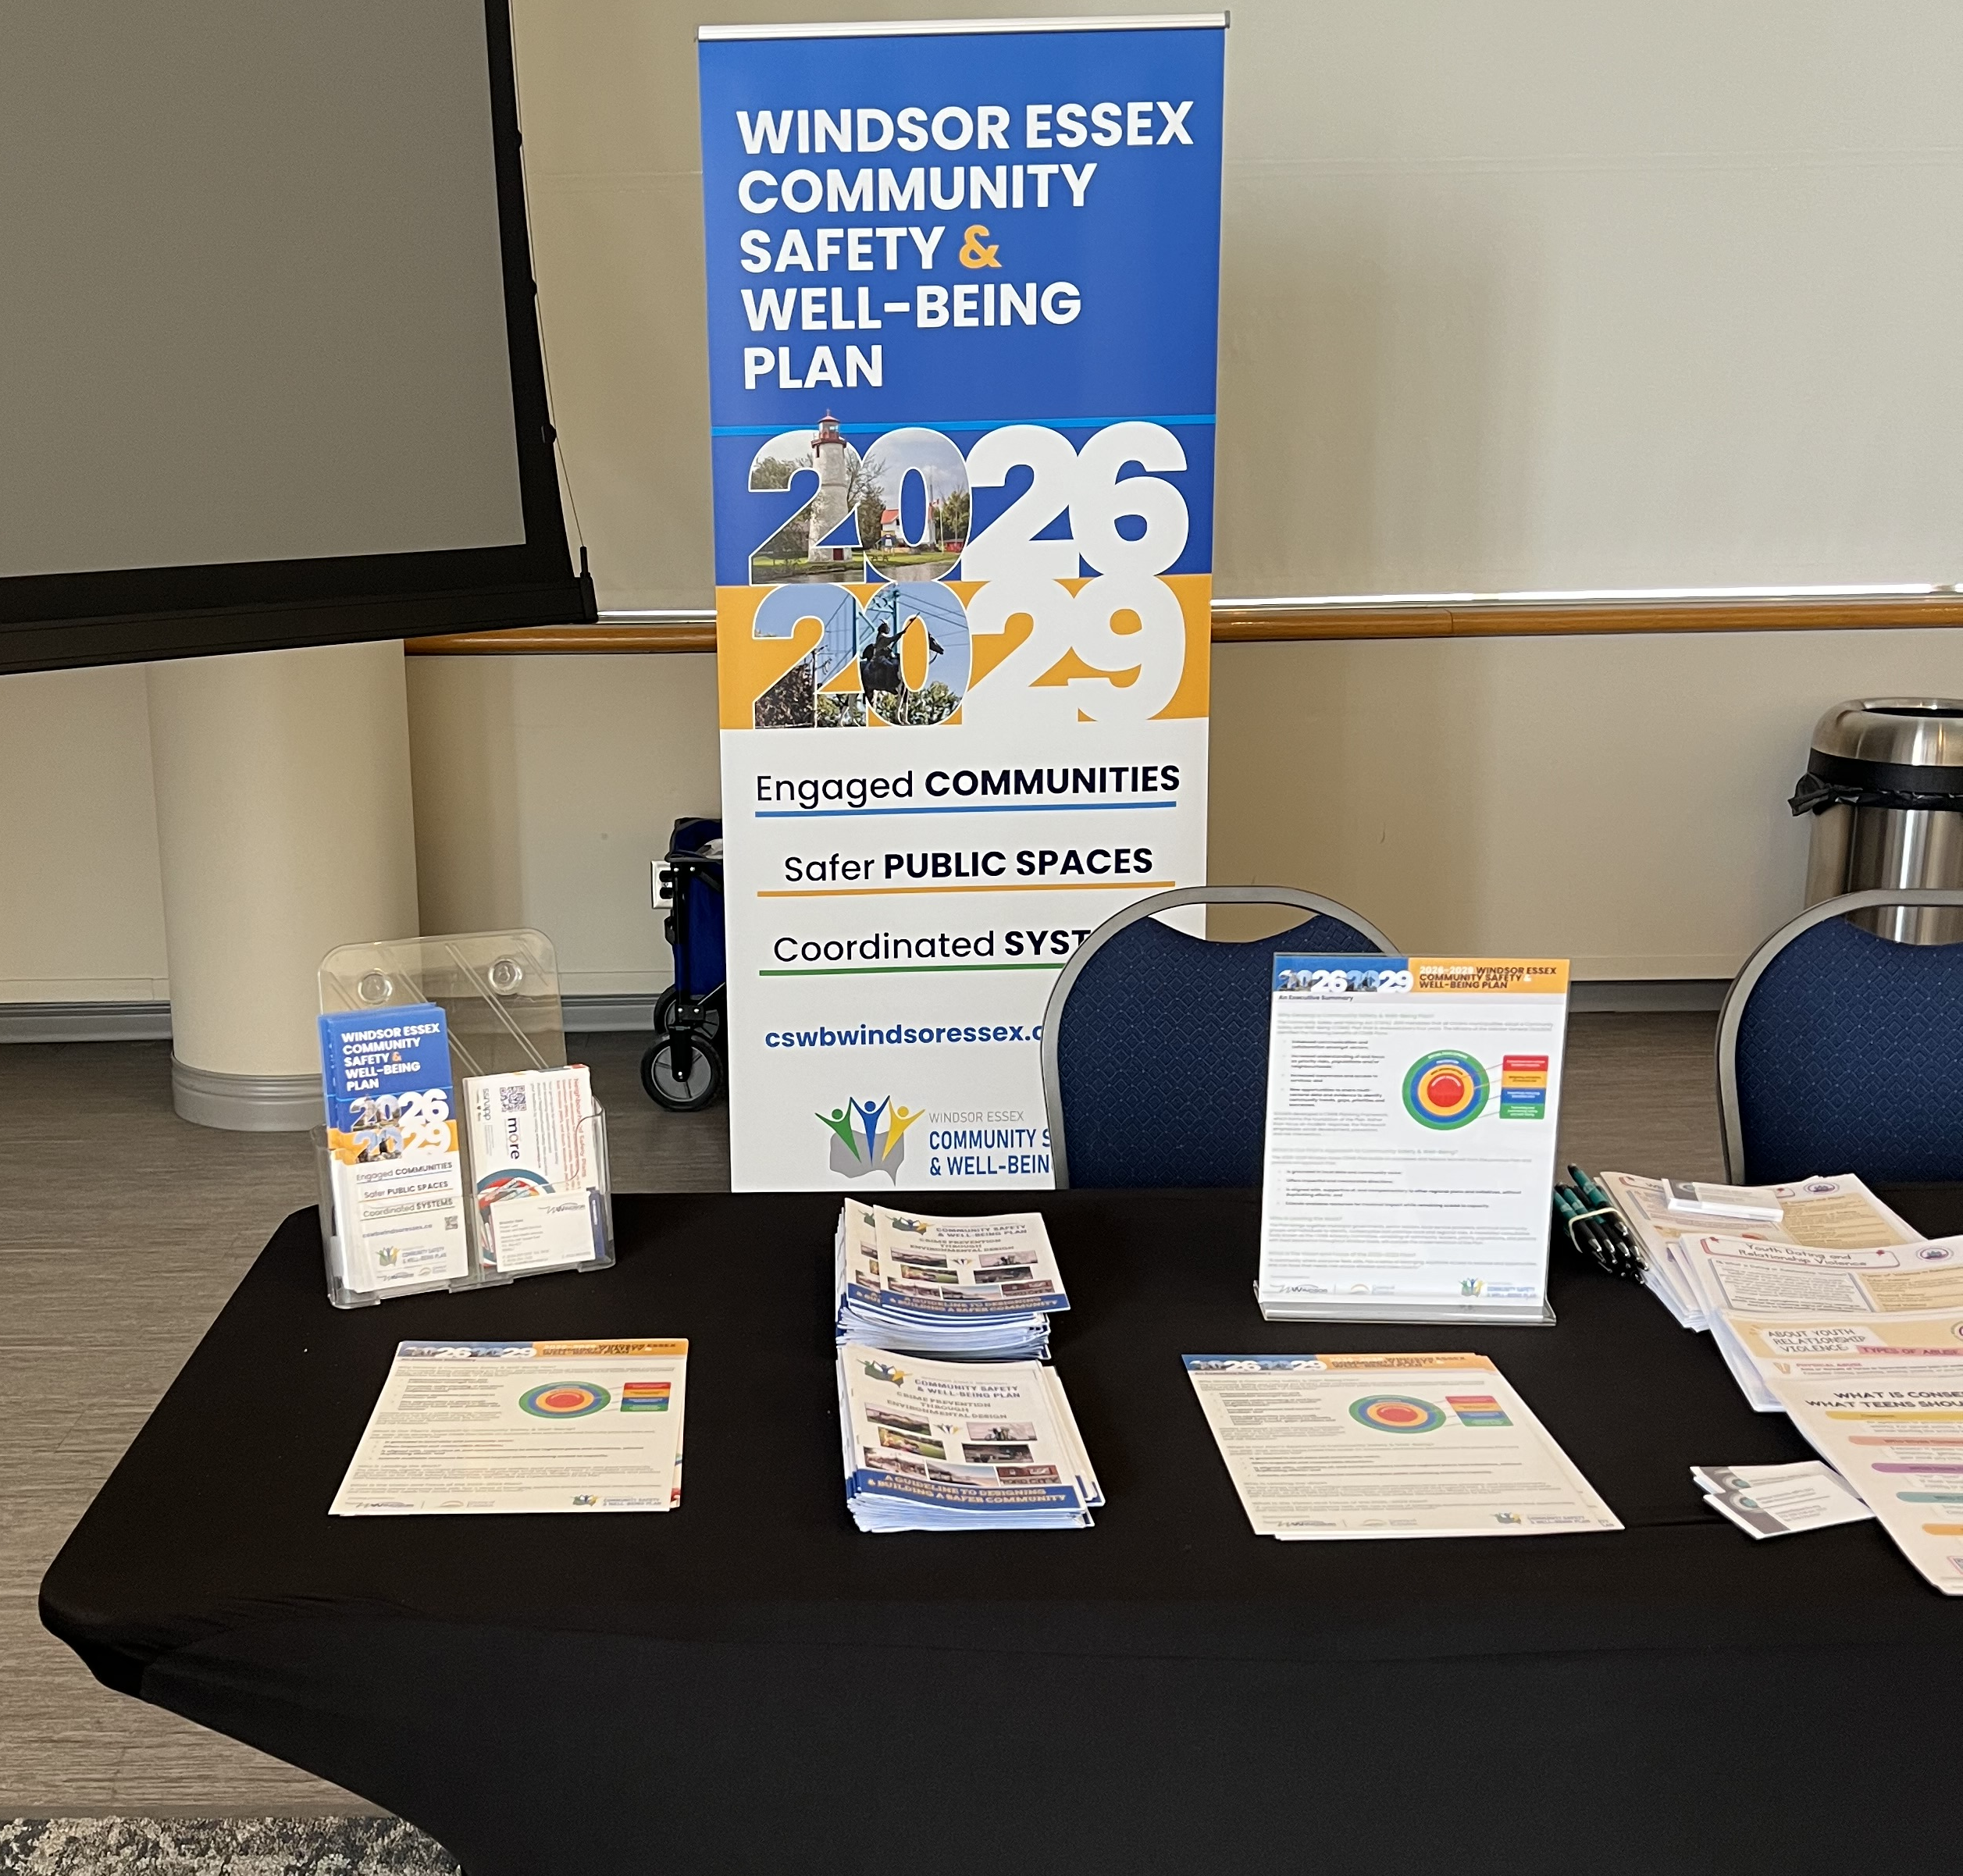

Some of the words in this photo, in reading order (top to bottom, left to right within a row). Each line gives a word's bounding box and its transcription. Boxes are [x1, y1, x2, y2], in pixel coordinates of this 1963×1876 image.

[736, 105, 1010, 155] WINDSOR
[1025, 101, 1194, 148] ESSEX
[737, 162, 1098, 214] COMMUNITY
[739, 226, 946, 273] SAFETY
[959, 224, 1003, 269] &
[740, 282, 1081, 332] WELL-BEING
[743, 344, 883, 390] PLAN
[747, 421, 1189, 585] 2026
[752, 575, 1186, 729] 2029
[756, 771, 914, 810] Engaged
[925, 764, 1181, 798] COMMUNITIES
[784, 853, 886, 882] Safer
[884, 850, 1007, 880] PUBLIC
[1016, 847, 1153, 877] SPACES
[773, 931, 995, 963] Coordinated
[1485, 974, 1522, 982] SAFETY
[1527, 966, 1557, 975] ESSEX
[1419, 981, 1480, 989] WELL-BEING
[341, 1027, 402, 1044] WINDSOR
[404, 1023, 440, 1037] ESSEX
[342, 1037, 421, 1055] COMMUNITY
[344, 1052, 390, 1067] SAFETY
[344, 1061, 421, 1080] WELL-BEING
[346, 1078, 379, 1092] PLAN
[349, 1088, 450, 1131] 2026
[928, 1112, 983, 1123] WINDSOR
[987, 1111, 1024, 1122] ESSEX
[352, 1122, 451, 1162] 2029
[508, 1117, 520, 1160] more
[929, 1129, 1037, 1150] COMMUNITY
[356, 1170, 394, 1182] Engaged
[395, 1162, 453, 1176] COMMUNITIES
[929, 1156, 942, 1177] &
[947, 1154, 1052, 1176] WELL-BEIN
[387, 1185, 415, 1195] PUBLIC
[417, 1181, 449, 1191] SPACES
[363, 1204, 415, 1217] Coordinated
[416, 1198, 454, 1210] SYSTEMS
[1745, 1244, 1783, 1254] Youth
[1772, 1336, 1866, 1344] RELATIONSHIP
[914, 1379, 977, 1391] COMMUNITY
[928, 1388, 991, 1398] WELL-BEING
[886, 1399, 971, 1419] ENVIRONMENTAL
[896, 1391, 929, 1401] CRIME
[930, 1397, 992, 1408] PREVENTION
[920, 1402, 969, 1412] THROUGH
[877, 1479, 935, 1497] BUILDING
[946, 1493, 984, 1504] SAFER
[985, 1494, 1067, 1504] COMMUNITY
[895, 1476, 959, 1494] GUIDELINE
